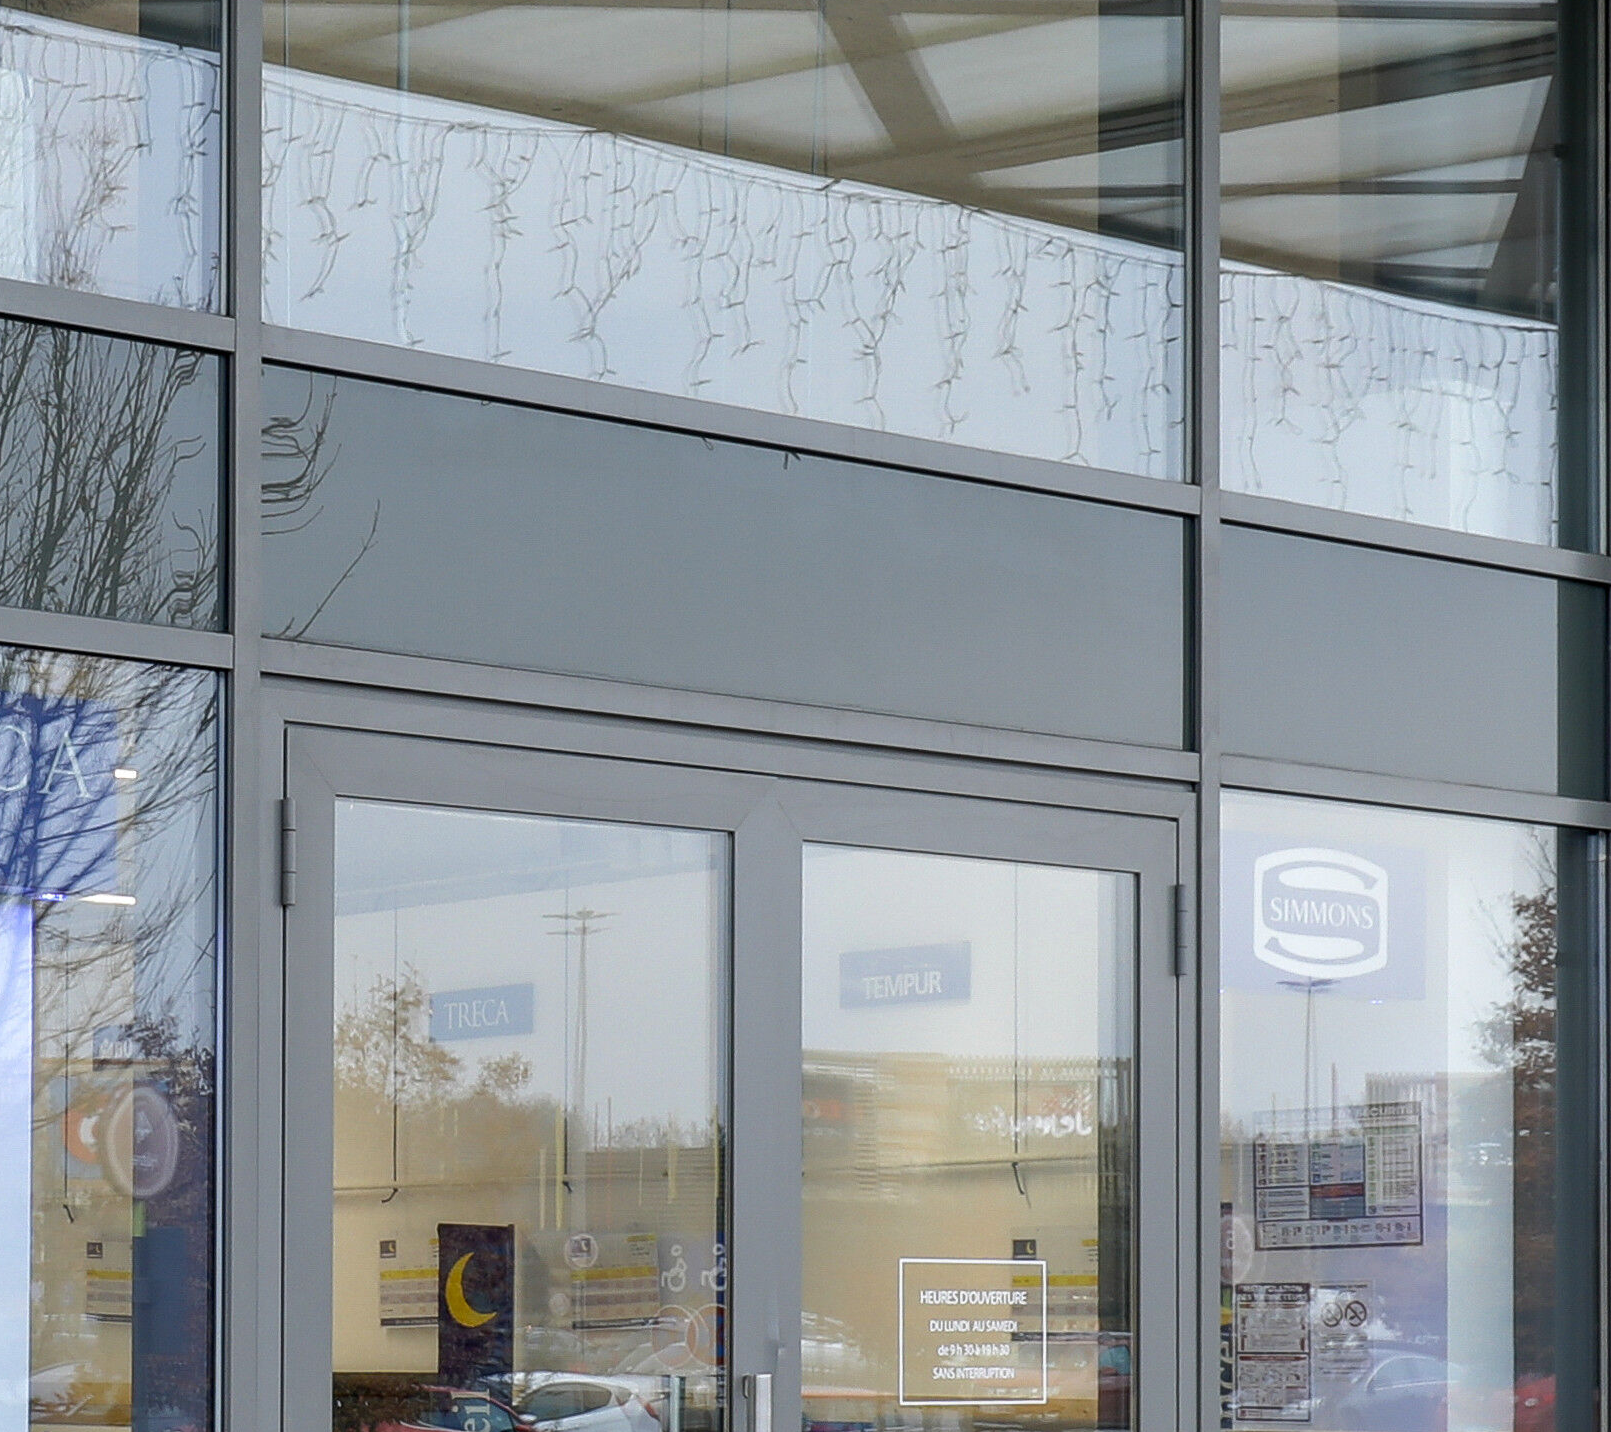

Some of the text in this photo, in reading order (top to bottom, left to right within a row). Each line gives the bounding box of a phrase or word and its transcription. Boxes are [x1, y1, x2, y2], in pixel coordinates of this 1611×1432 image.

[1270, 896, 1374, 930] SIMMONS
[863, 970, 942, 1000] TEMPUR
[443, 999, 510, 1029] TRECA
[920, 1290, 1027, 1305] HEURES D'OUVERTURE
[930, 1320, 1018, 1332] DU LUNDI AU SAMEDI
[932, 1367, 1015, 1379] SANS INTERRUPTION
